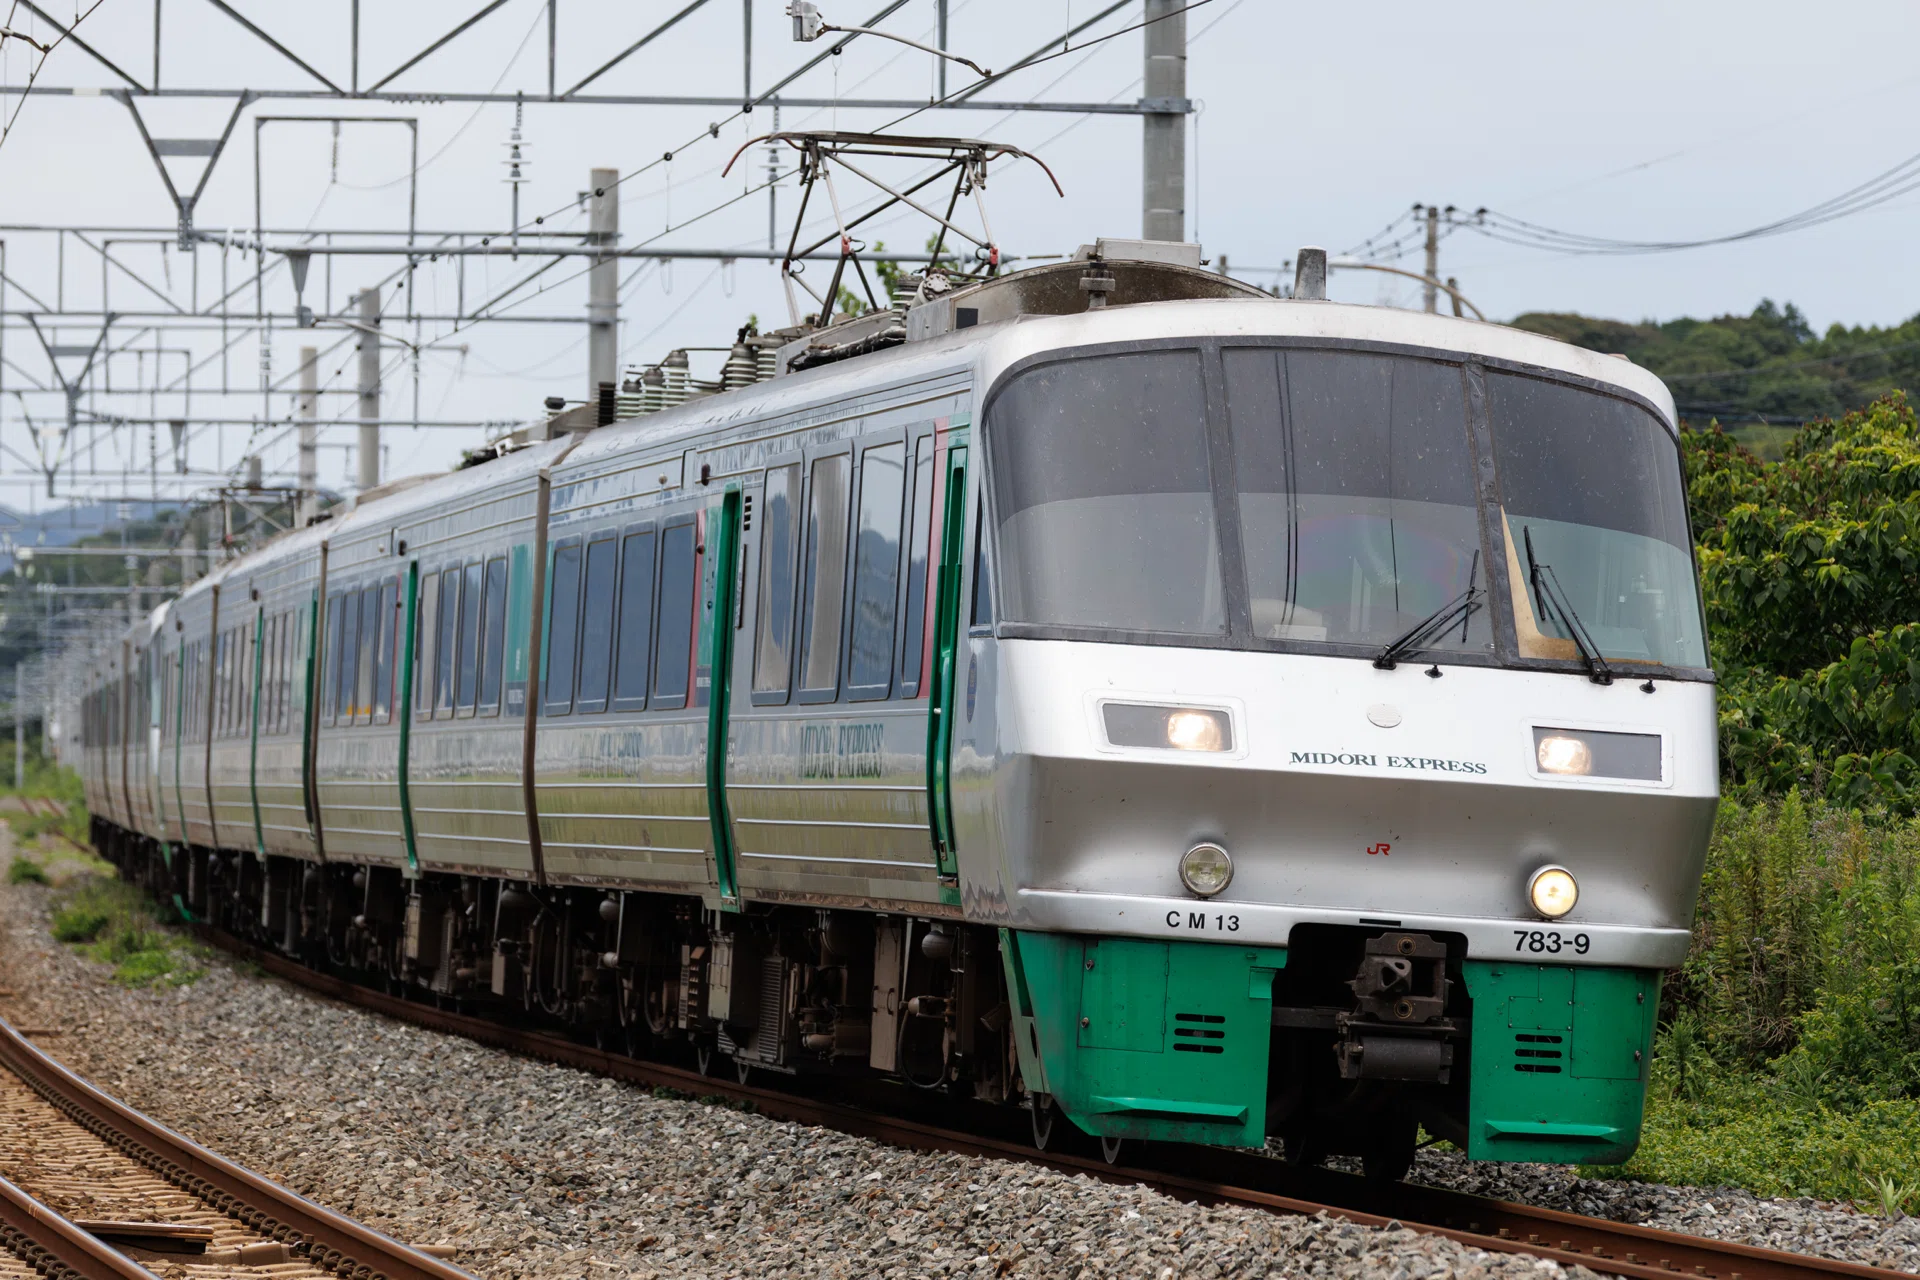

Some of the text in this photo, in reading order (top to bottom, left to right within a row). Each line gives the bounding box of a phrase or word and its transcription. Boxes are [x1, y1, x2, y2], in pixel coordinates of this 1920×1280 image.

[799, 723, 884, 780] MIDORI EXPRESS
[1289, 751, 1488, 775] MIDORI EXPRESS
[1366, 842, 1391, 856] JR
[1513, 930, 1591, 955] 783-9
